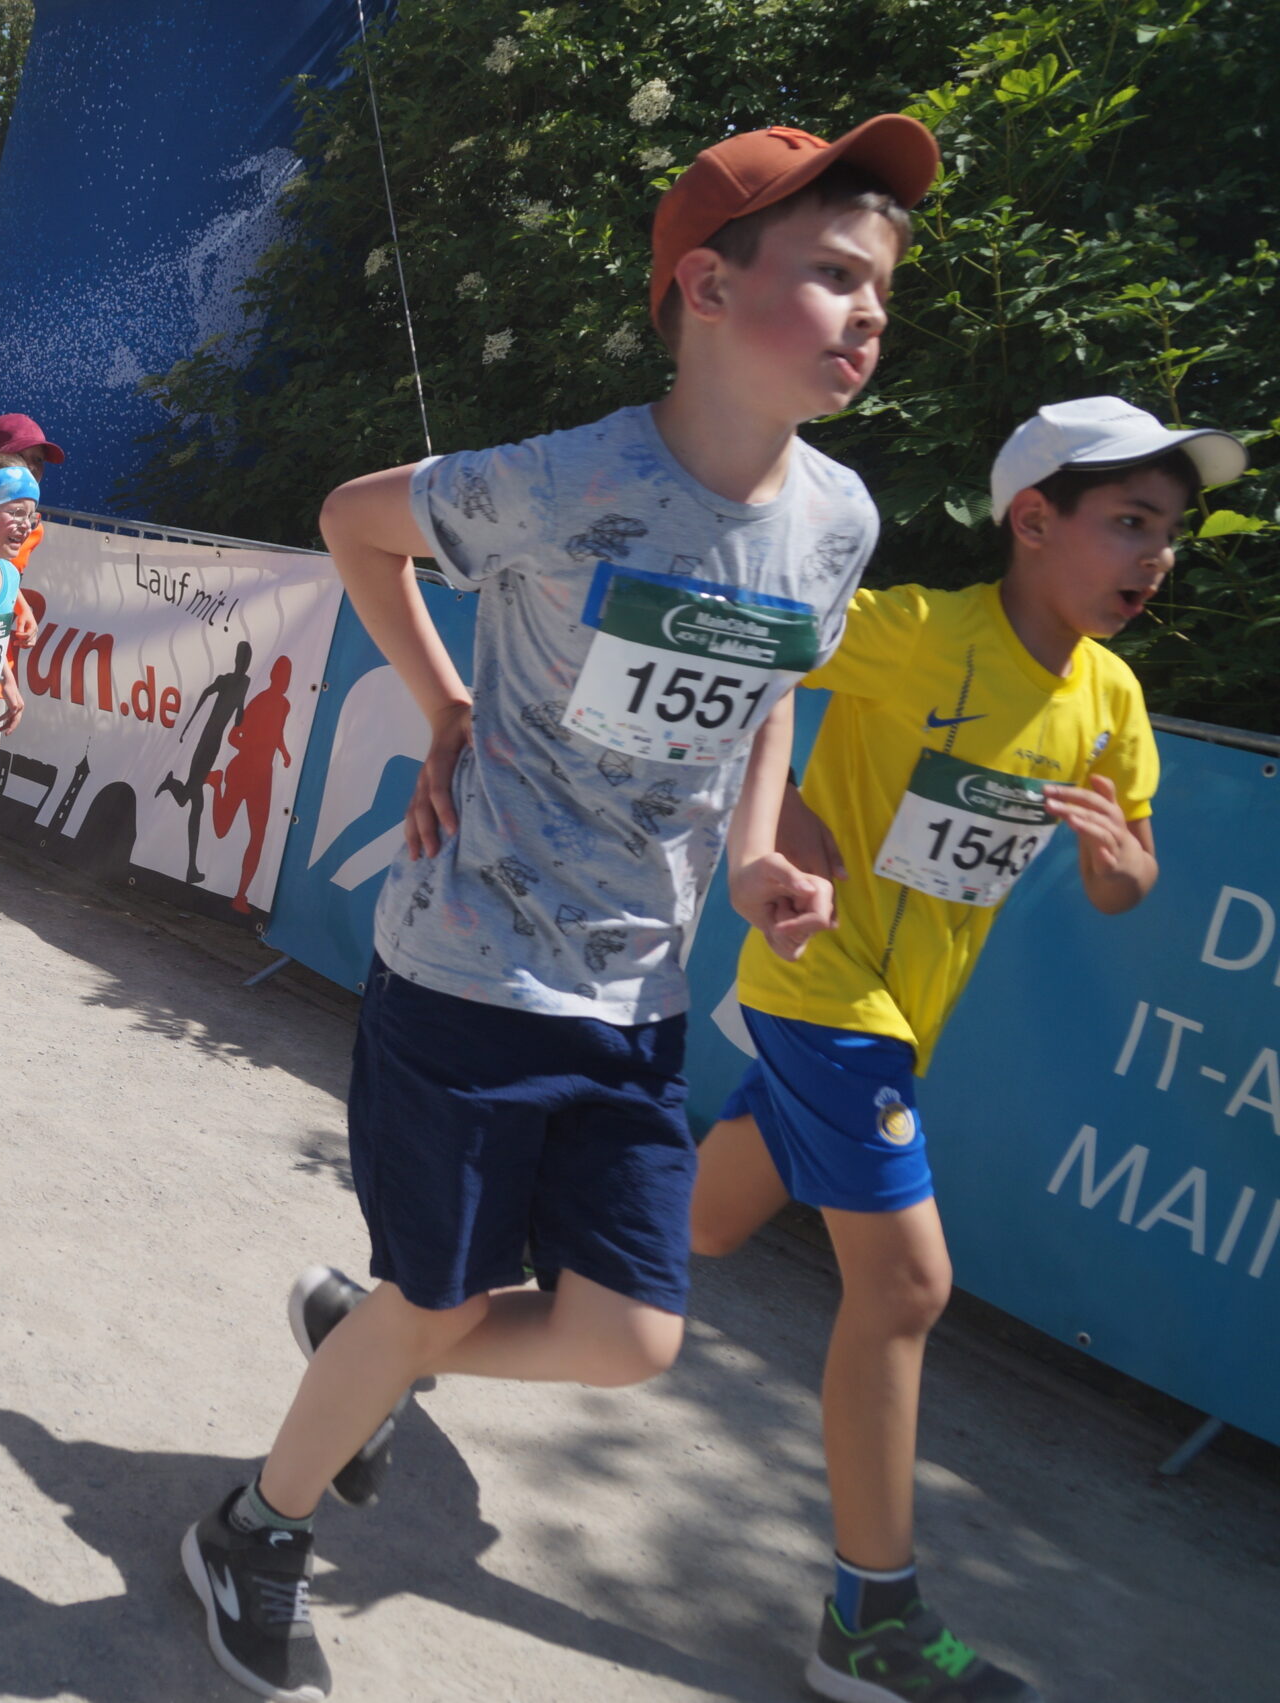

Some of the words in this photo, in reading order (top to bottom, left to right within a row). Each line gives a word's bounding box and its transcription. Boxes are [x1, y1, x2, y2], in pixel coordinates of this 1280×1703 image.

[136, 553, 191, 607] Lauf
[626, 661, 769, 730] 1551
[928, 818, 1039, 876] 1543
[1201, 885, 1280, 987] D
[1046, 1123, 1280, 1280] MAI
